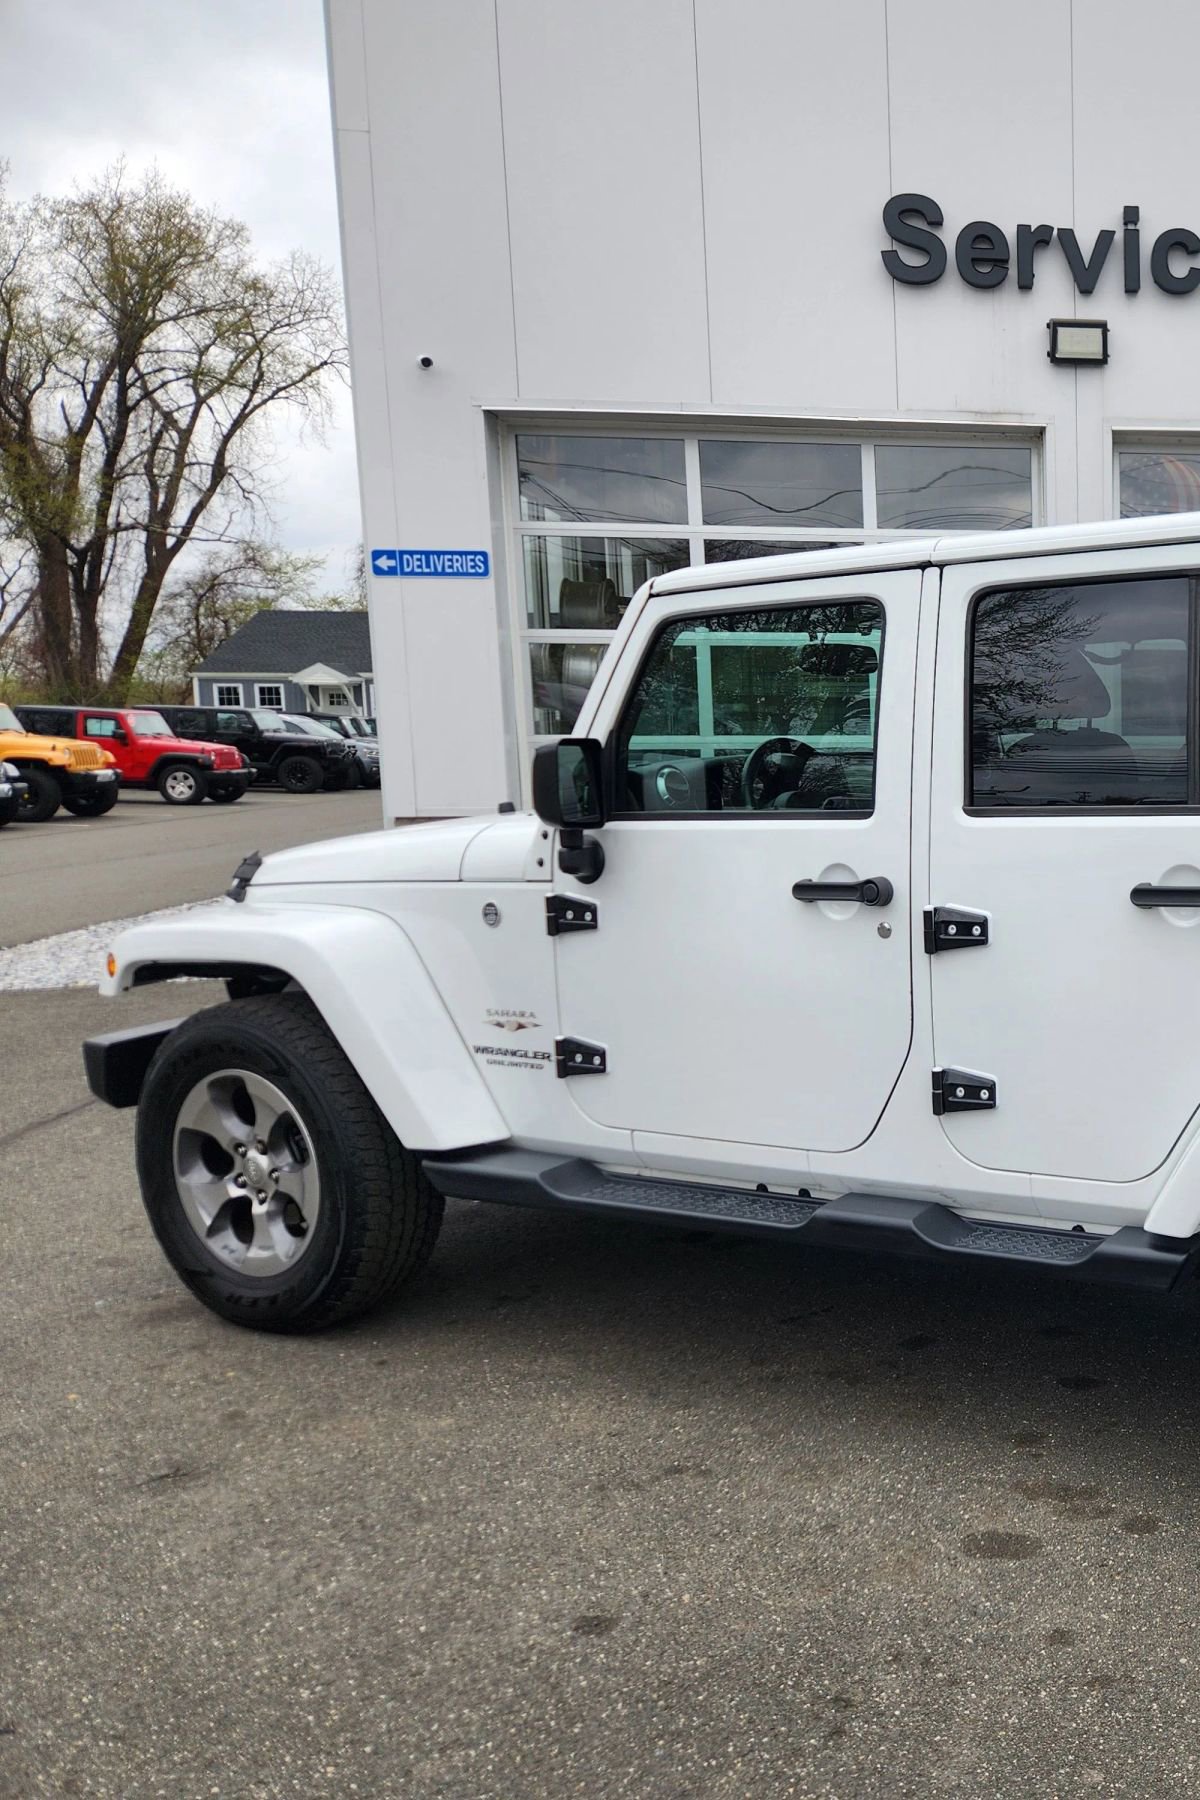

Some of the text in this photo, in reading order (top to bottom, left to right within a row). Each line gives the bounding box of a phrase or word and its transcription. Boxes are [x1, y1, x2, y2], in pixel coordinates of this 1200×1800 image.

[403, 554, 485, 573] DELIVERIES
[486, 1008, 537, 1019] SAHARA
[473, 1045, 553, 1062] WRANGLER
